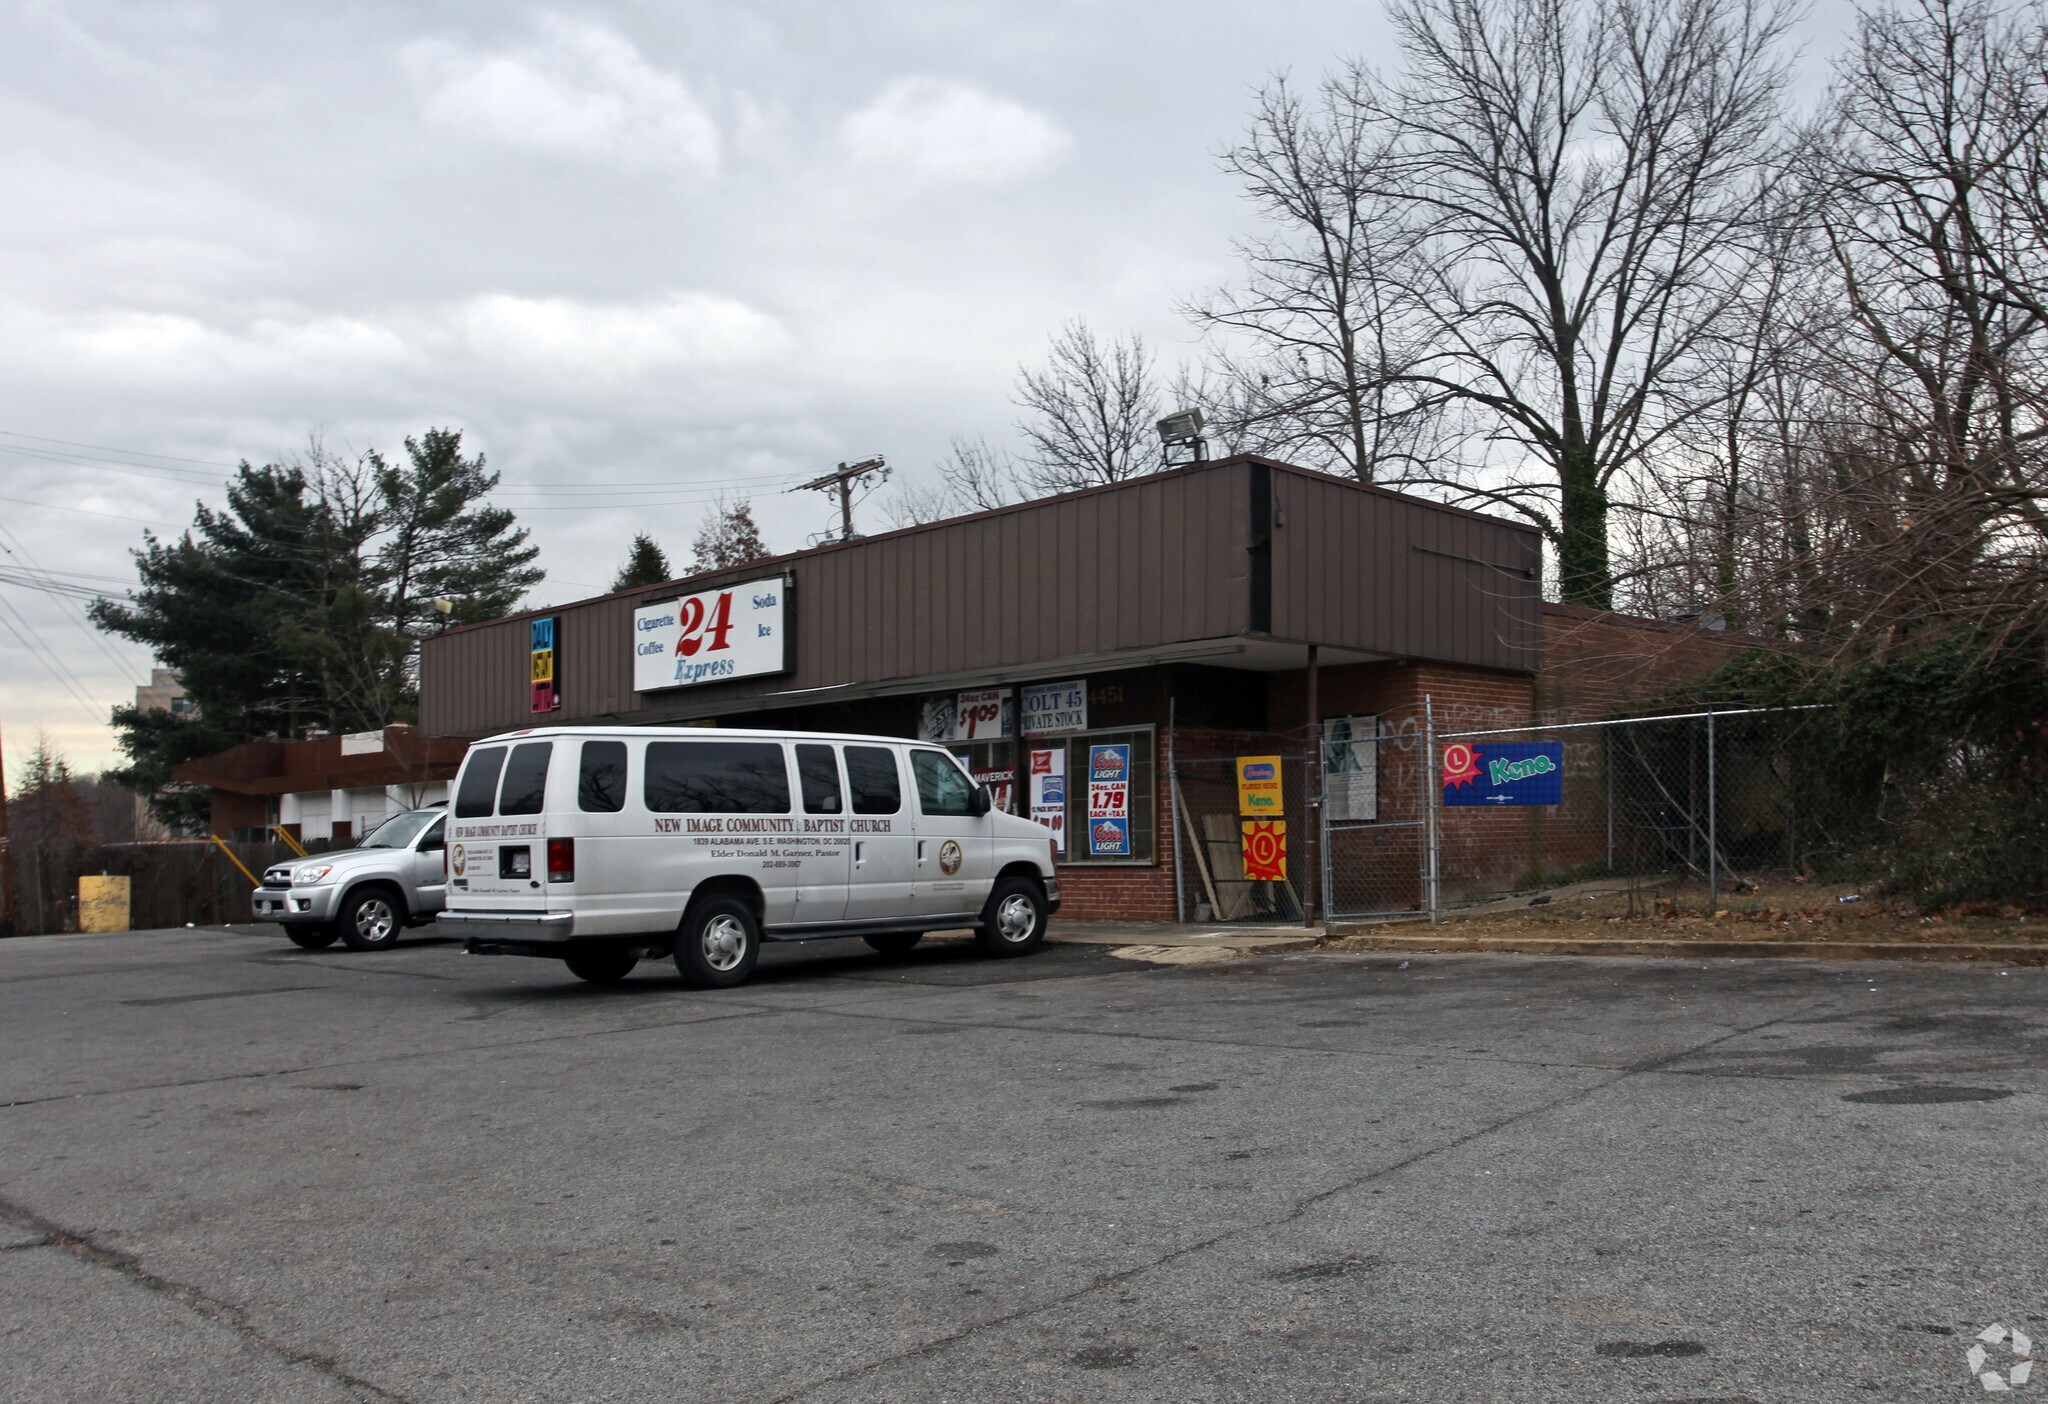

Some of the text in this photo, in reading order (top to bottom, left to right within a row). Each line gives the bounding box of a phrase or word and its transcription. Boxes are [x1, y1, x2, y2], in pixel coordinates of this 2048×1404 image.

[752, 594, 776, 609] Soda
[637, 615, 674, 632] Cigarette
[675, 592, 734, 657] 24
[758, 624, 771, 637] Ice
[637, 642, 664, 656] Coffee
[674, 659, 734, 682] Express
[981, 691, 999, 701] CAN
[1021, 691, 1082, 713] COLT 45
[1055, 710, 1083, 727] STOCK
[1453, 752, 1463, 767] L
[973, 770, 1014, 783] MAVERICK
[1094, 769, 1121, 779] LIGHT
[1092, 791, 1124, 809] 1.79
[1090, 810, 1107, 818] EACH
[655, 818, 891, 833] NEW IMAGE COMMUNITY BAPTIST CHURCH
[711, 850, 734, 858] Elder
[736, 849, 767, 857] Donald
[770, 849, 780, 857] M.
[815, 849, 840, 857] Pastor
[1095, 842, 1121, 851] LIGHT
[1261, 840, 1268, 856] L
